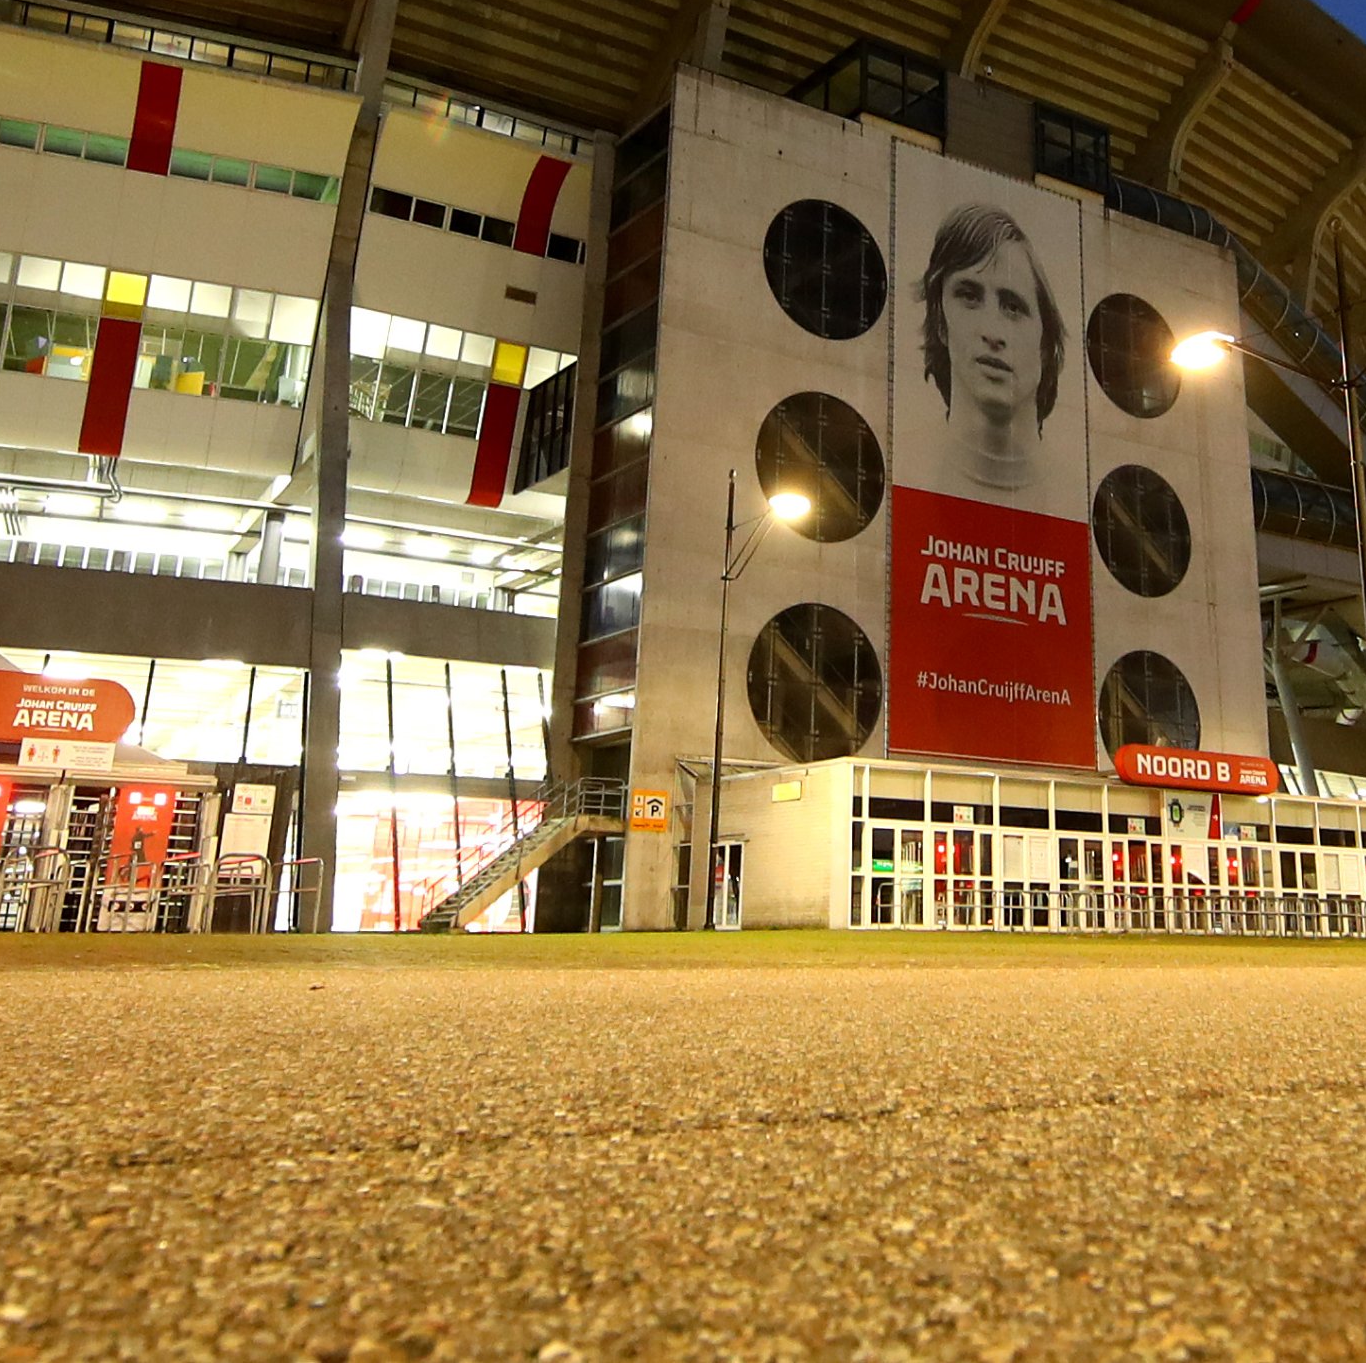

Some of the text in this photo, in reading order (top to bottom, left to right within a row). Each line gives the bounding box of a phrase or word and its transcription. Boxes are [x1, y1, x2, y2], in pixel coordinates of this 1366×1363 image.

[921, 535, 989, 566] JOHAN
[920, 563, 1067, 626] ARENA
[22, 684, 96, 697] WELKOM IN DE
[917, 671, 1071, 706] #JohanCruijffArenA
[16, 697, 55, 710] JOHAN
[12, 709, 94, 732] ARENA
[1136, 753, 1231, 783] NOORD B
[1239, 774, 1268, 787] ARENA
[651, 805, 659, 817] P
